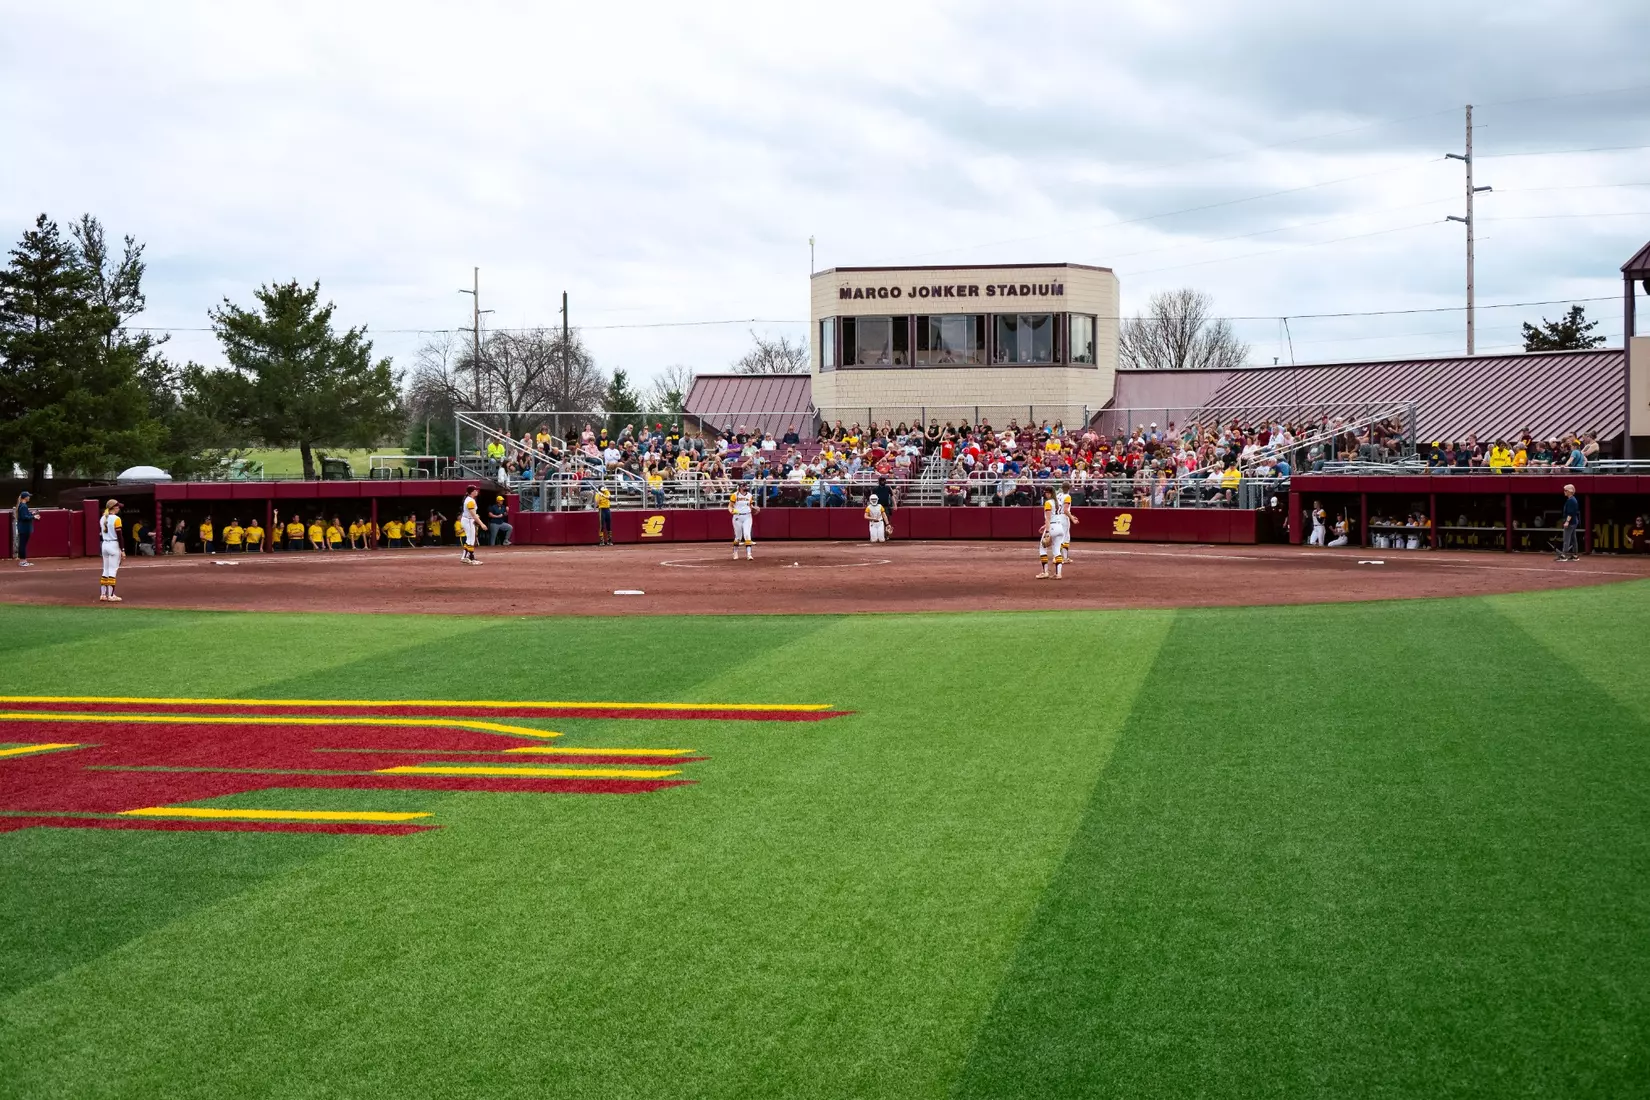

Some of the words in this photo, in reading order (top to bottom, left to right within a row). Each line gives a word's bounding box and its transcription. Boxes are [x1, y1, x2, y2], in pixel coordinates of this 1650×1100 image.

[839, 287, 902, 300] MARGO
[907, 285, 980, 299] JONKER
[985, 283, 1064, 297] STADIUM
[600, 440, 608, 448] M
